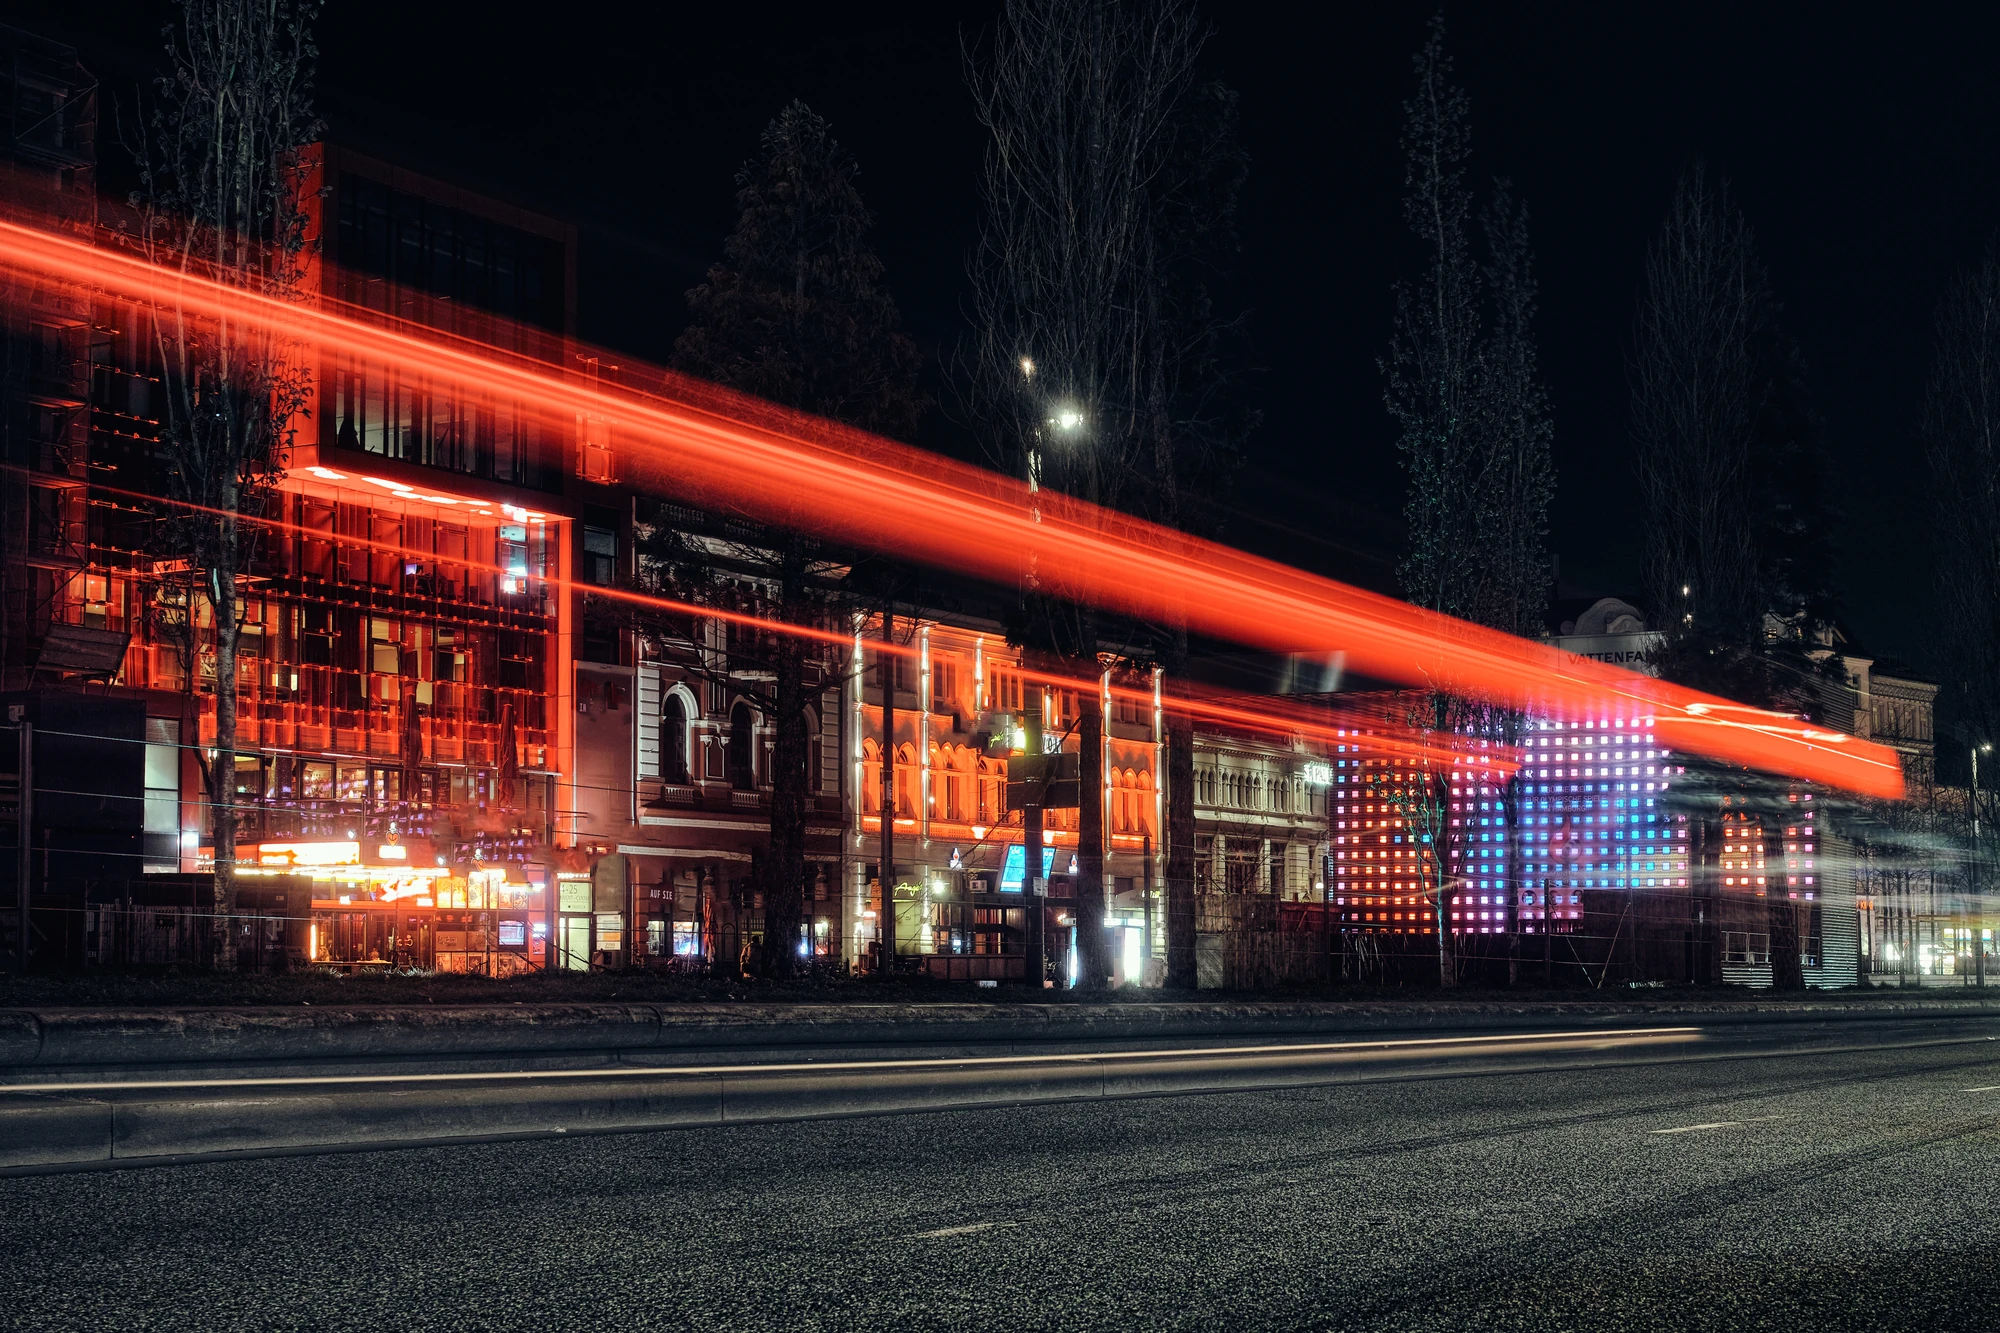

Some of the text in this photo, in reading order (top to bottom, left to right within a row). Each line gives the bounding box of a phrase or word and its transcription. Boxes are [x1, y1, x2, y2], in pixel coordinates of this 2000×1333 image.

[1567, 651, 1652, 665] VATTENFA
[650, 889, 673, 900] AUF SIE
